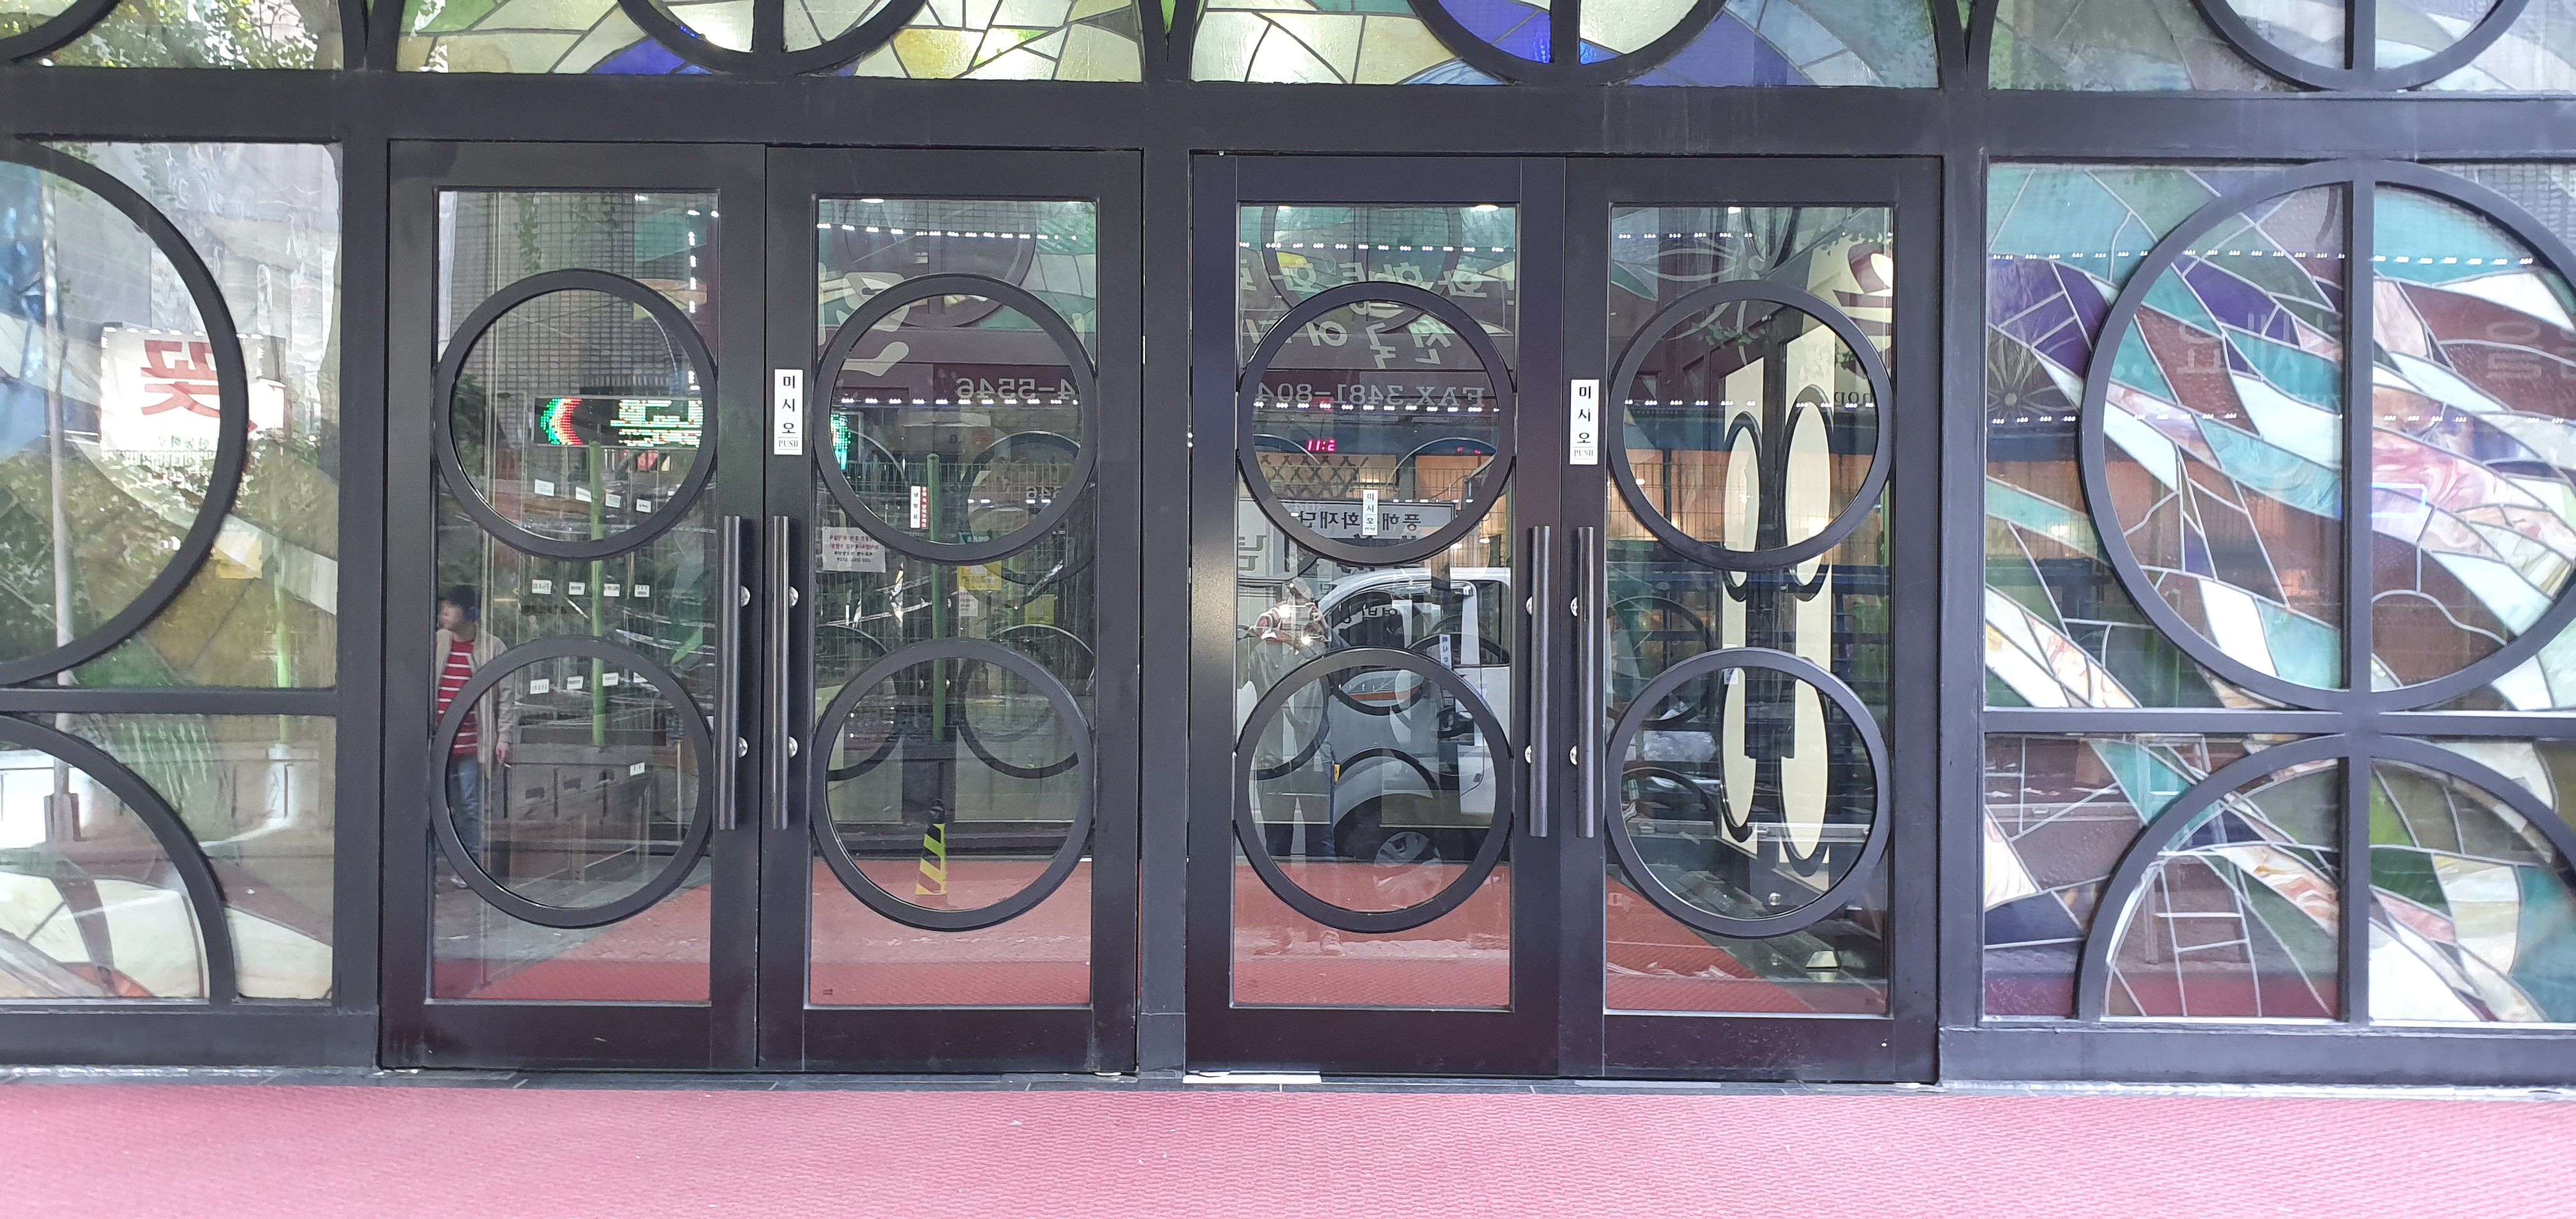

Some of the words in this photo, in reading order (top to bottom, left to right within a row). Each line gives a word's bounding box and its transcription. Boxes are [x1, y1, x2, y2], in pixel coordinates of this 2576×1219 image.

[781, 375, 796, 434] 미시오
[1577, 385, 1591, 443] 미시오
[1366, 492, 1374, 524] 미시오
